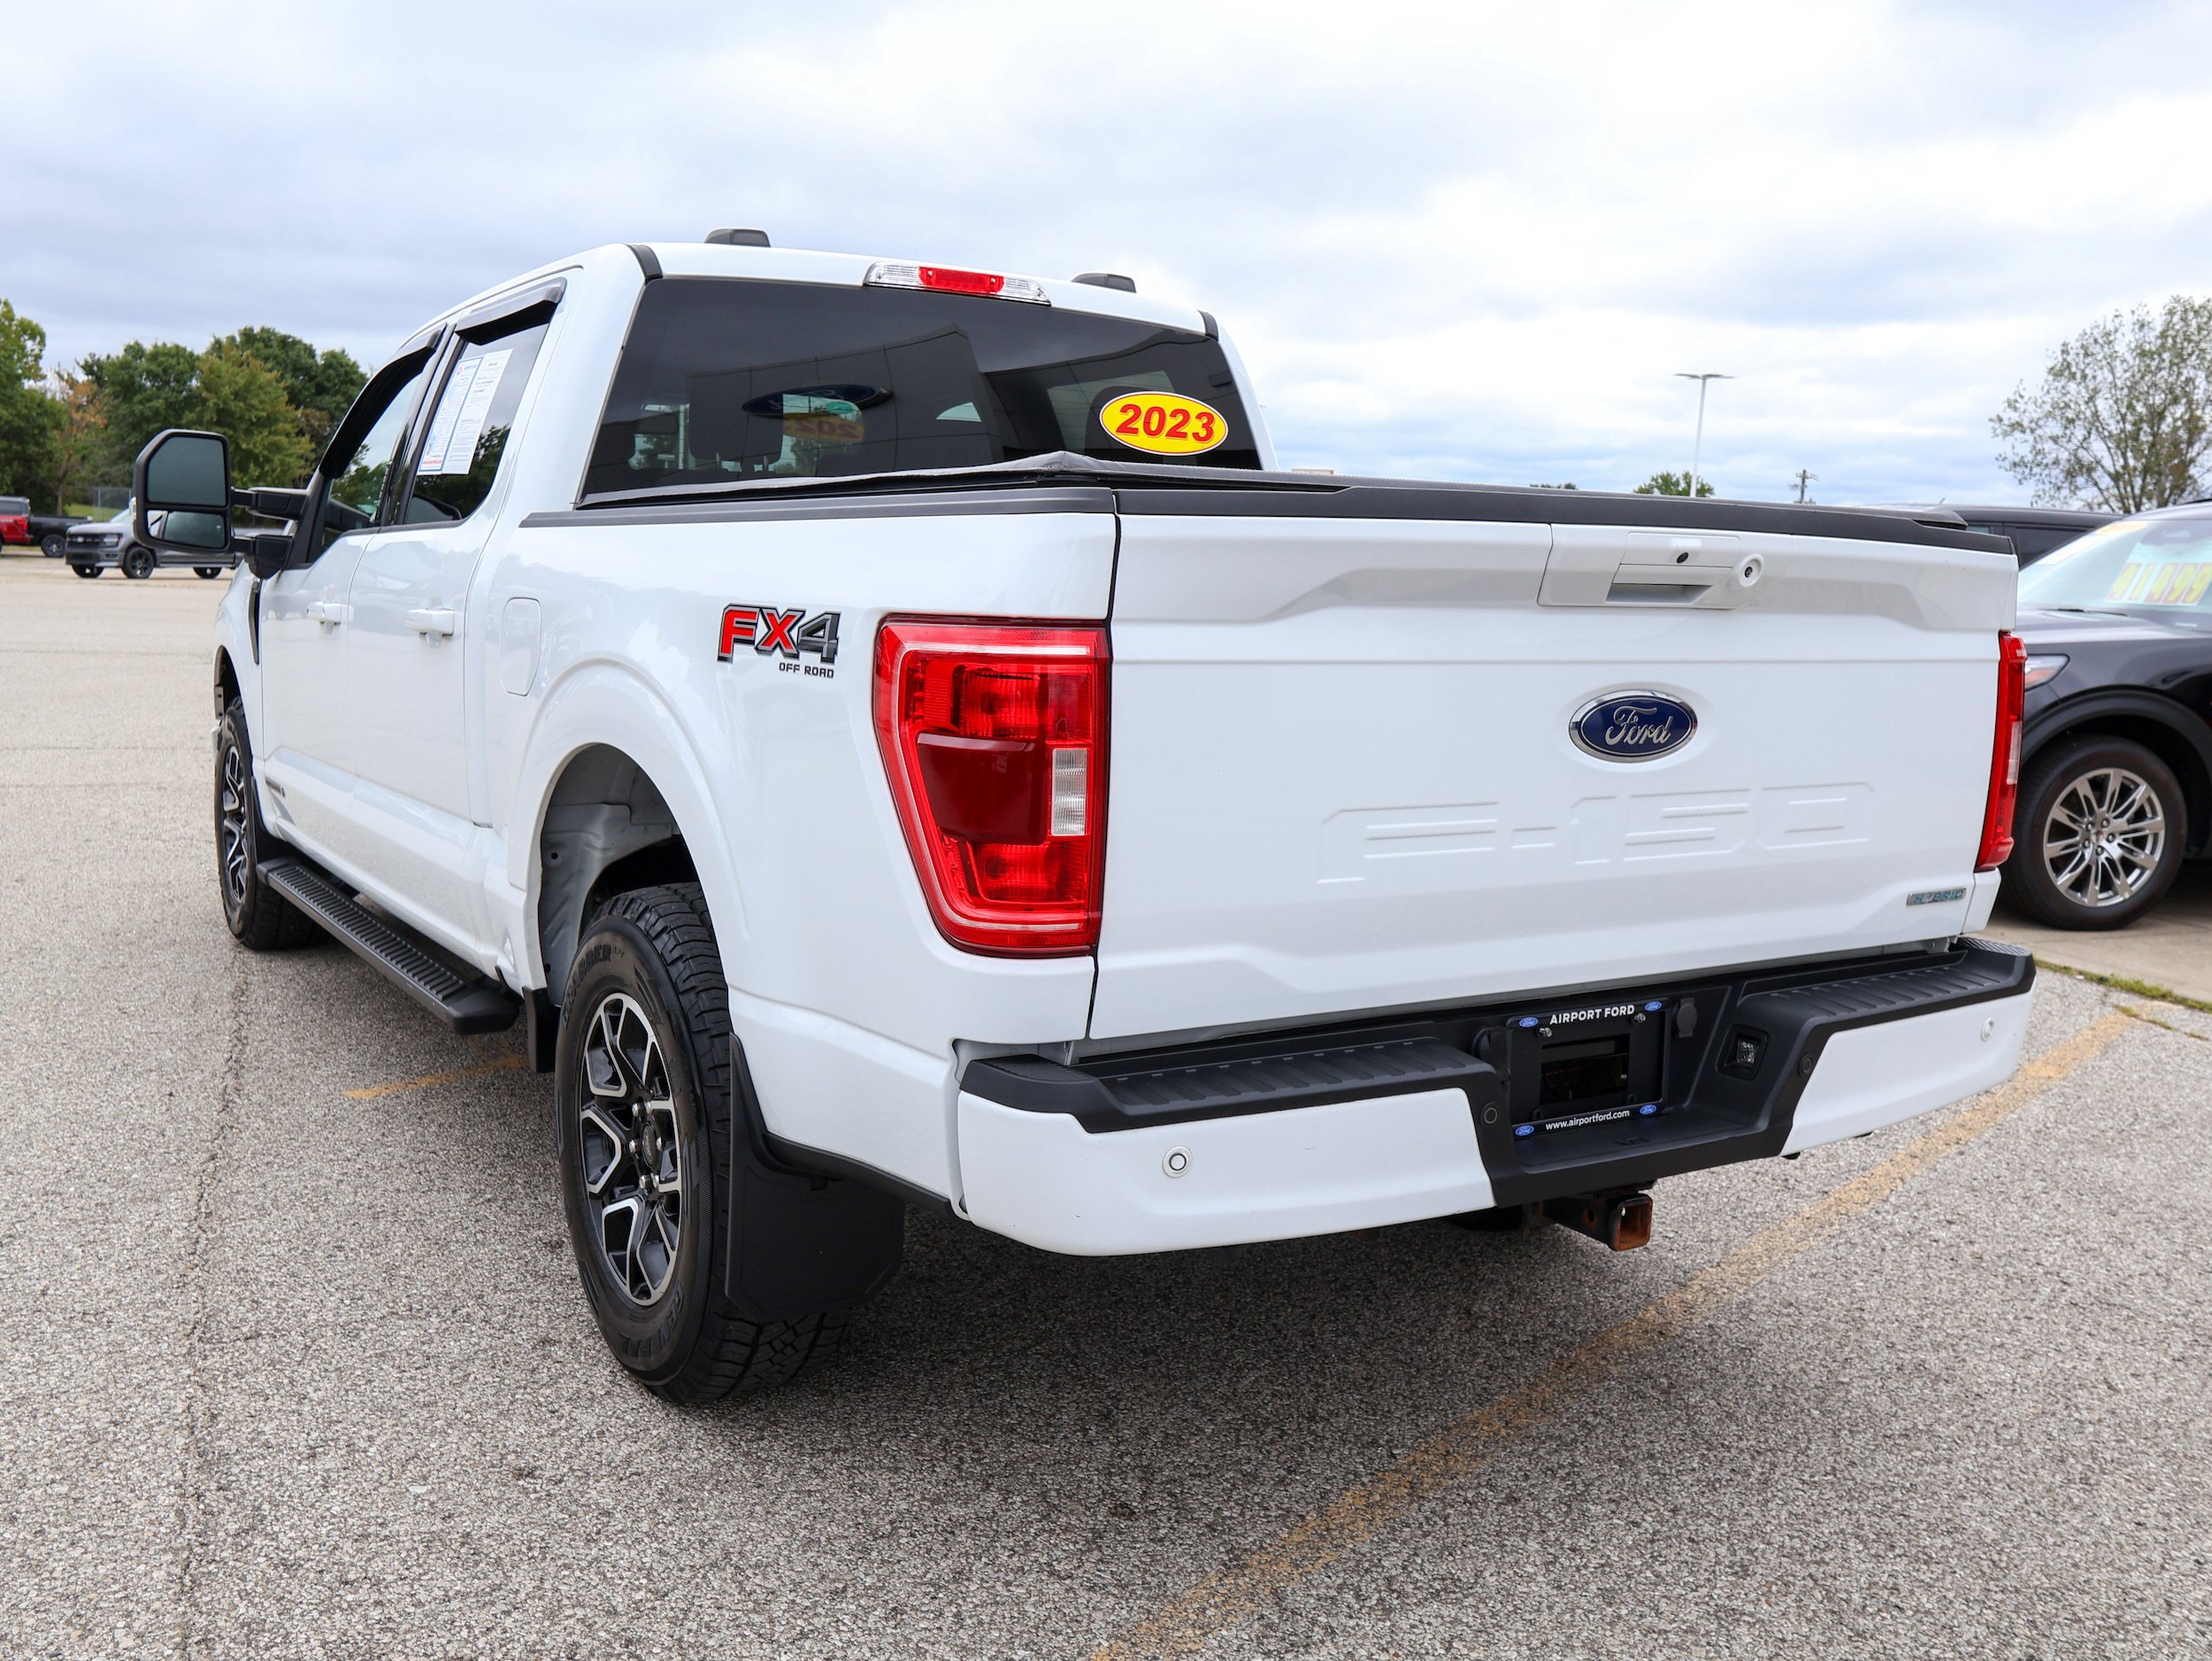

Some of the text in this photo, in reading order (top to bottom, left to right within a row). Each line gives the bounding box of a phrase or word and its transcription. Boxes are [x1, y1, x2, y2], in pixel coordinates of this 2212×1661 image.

[1115, 404, 1216, 442] 2023
[717, 603, 842, 665] FX4
[779, 662, 835, 679] OFF ROAD
[1604, 705, 1674, 746] Ford
[1549, 1004, 1635, 1026] AIRPORT FORD
[1545, 1109, 1630, 1131] www.airportford.com
